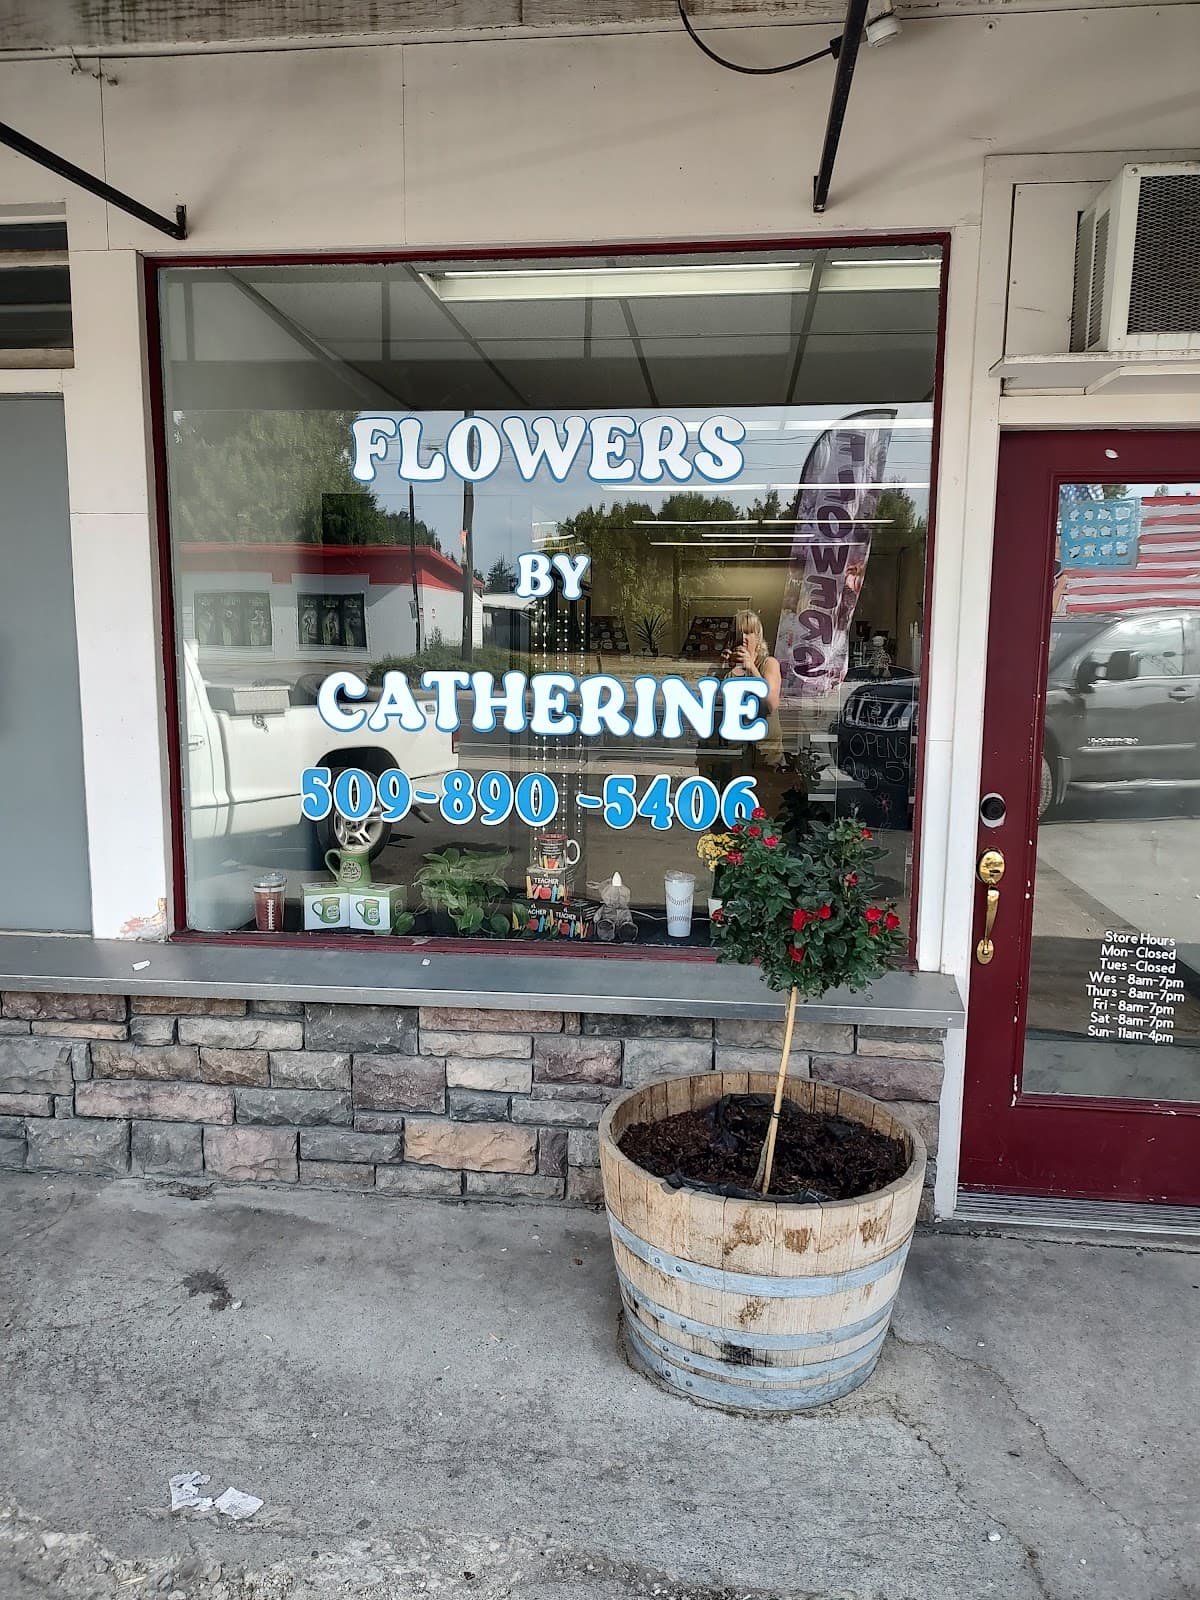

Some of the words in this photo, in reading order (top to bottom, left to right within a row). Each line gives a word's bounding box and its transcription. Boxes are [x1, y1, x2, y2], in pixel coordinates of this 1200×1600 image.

[352, 415, 745, 483] FLOWERS
[515, 552, 591, 600] BY
[317, 670, 769, 742] CATHERINE
[850, 731, 908, 759] OPENS
[300, 767, 559, 827] 509-890
[576, 774, 760, 831] -5406
[555, 911, 577, 920] TEACHER
[1105, 931, 1138, 943] Store
[1140, 933, 1176, 946] Hours
[1101, 944, 1134, 957] Mon-
[1136, 947, 1177, 960] Closed
[1100, 958, 1128, 971] Tues
[1089, 971, 1117, 983] Wes
[1127, 974, 1184, 989] 8am-7pm
[1086, 984, 1118, 997] Thurs
[1128, 987, 1185, 1003] 8am-7pm
[1093, 998, 1108, 1010] Fri
[1118, 1000, 1175, 1016] 8am-7pm
[1090, 1011, 1110, 1024] Sat
[1088, 1025, 1115, 1037] Sun-
[1118, 1027, 1174, 1044] 11am-4pm
